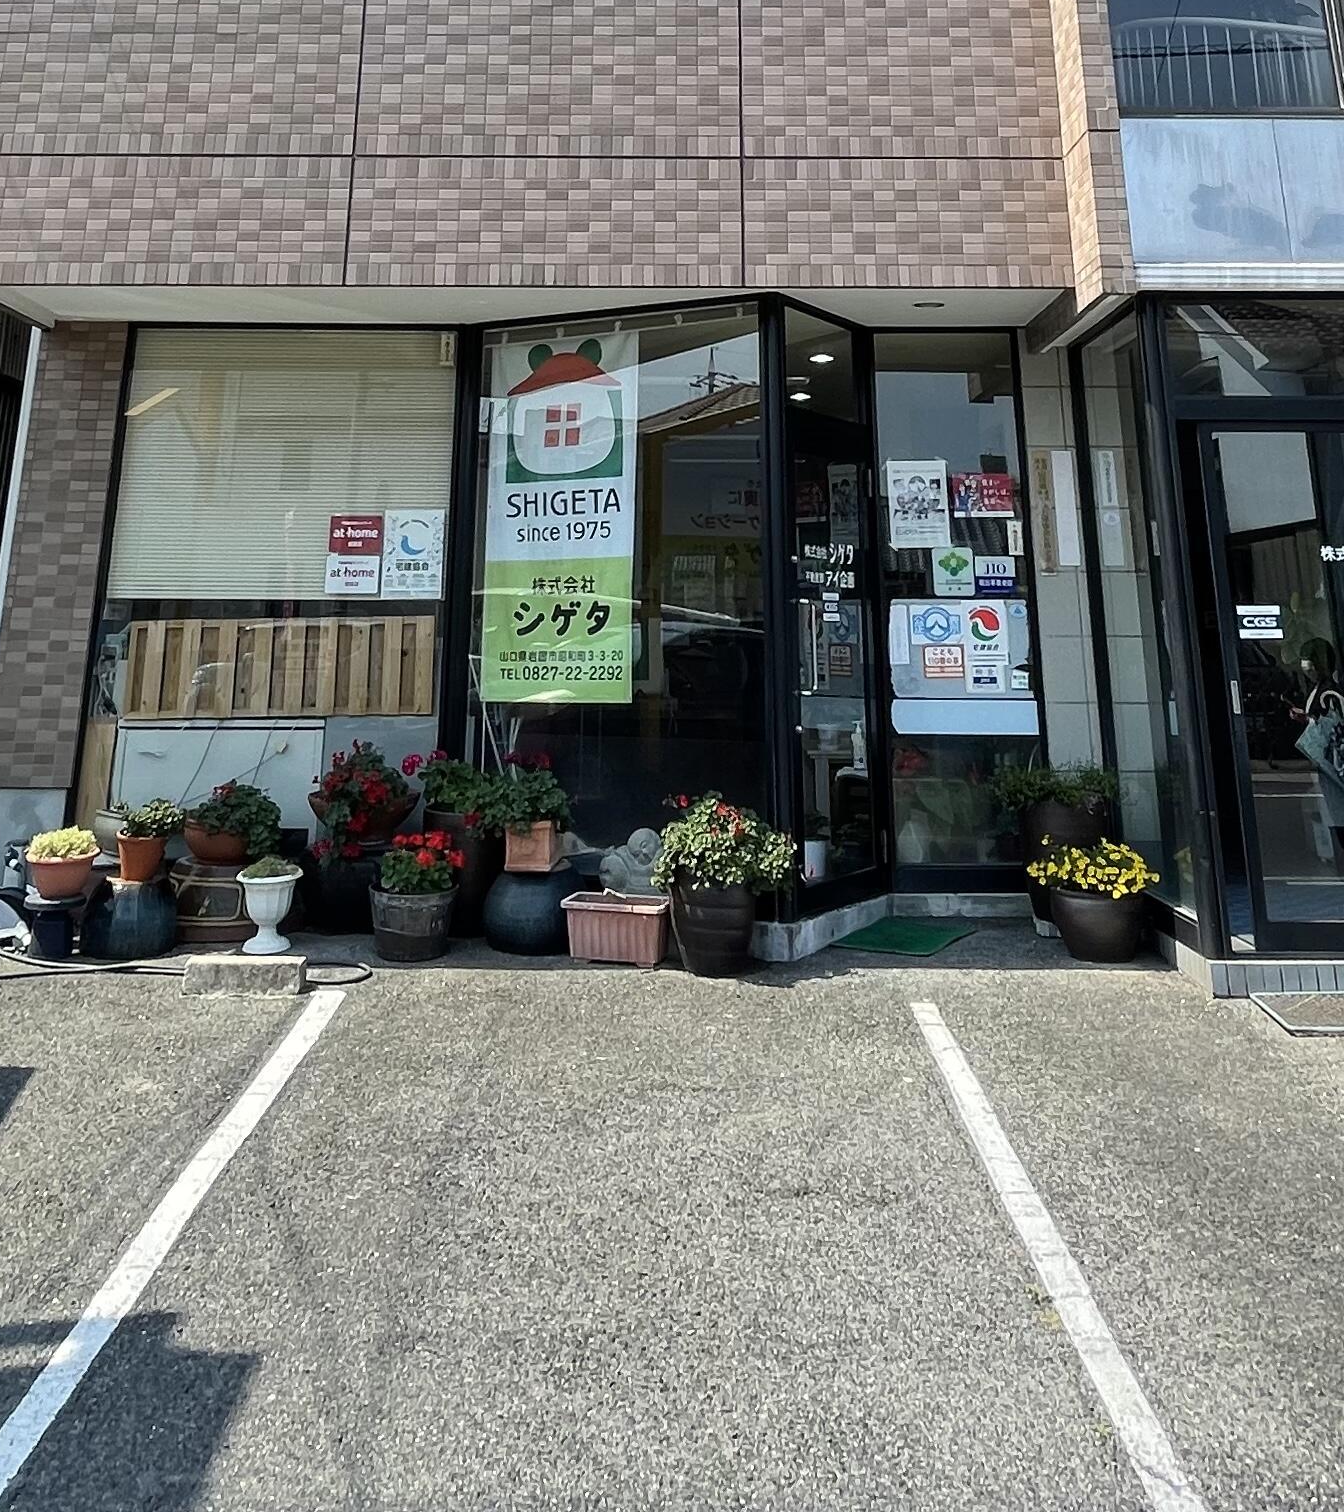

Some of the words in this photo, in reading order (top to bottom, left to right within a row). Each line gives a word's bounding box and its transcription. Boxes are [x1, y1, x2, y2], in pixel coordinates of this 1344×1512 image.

[506, 488, 622, 518] SHIGETA
[517, 523, 561, 542] since
[566, 521, 612, 540] 1975
[829, 542, 854, 564] シゲタ
[983, 562, 1007, 575] JIO
[532, 575, 596, 595] 株式会社
[513, 600, 611, 636] シゲタ
[1242, 616, 1277, 628] CGS
